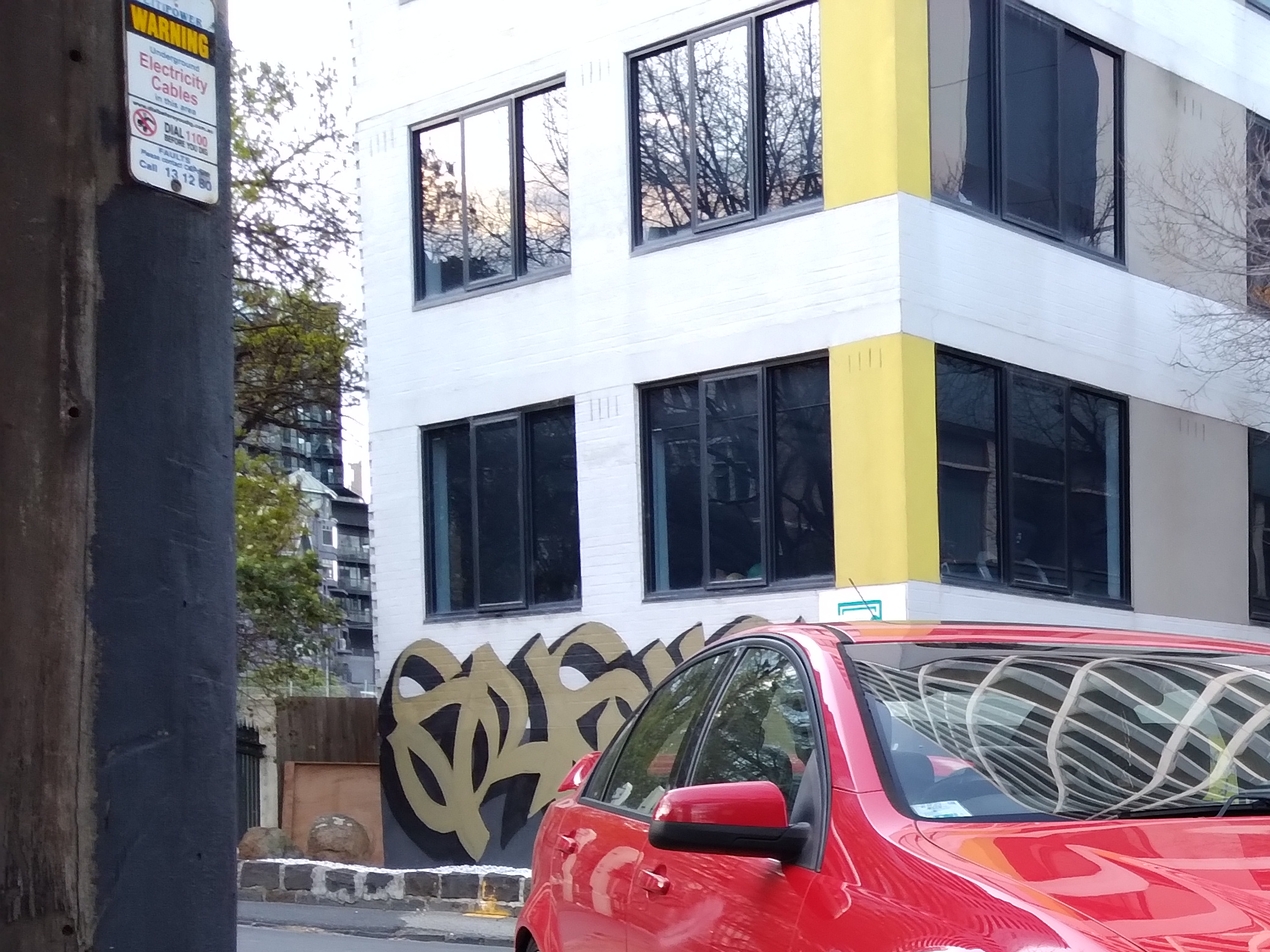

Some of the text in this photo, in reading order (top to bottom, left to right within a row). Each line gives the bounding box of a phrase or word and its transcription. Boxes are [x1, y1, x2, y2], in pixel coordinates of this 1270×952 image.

[130, 4, 210, 60] WARNING
[149, 46, 200, 73] Underground
[139, 52, 208, 95] Electricity
[151, 76, 199, 106] Cables
[155, 93, 197, 116] in this area
[164, 121, 208, 148] DIAL 1100
[164, 133, 208, 157] BEFORE YOU DIG
[140, 148, 182, 168] Please contact
[158, 147, 191, 164] FAULTS
[139, 159, 158, 172] Call
[165, 167, 178, 180] 13
[182, 173, 195, 186] 12
